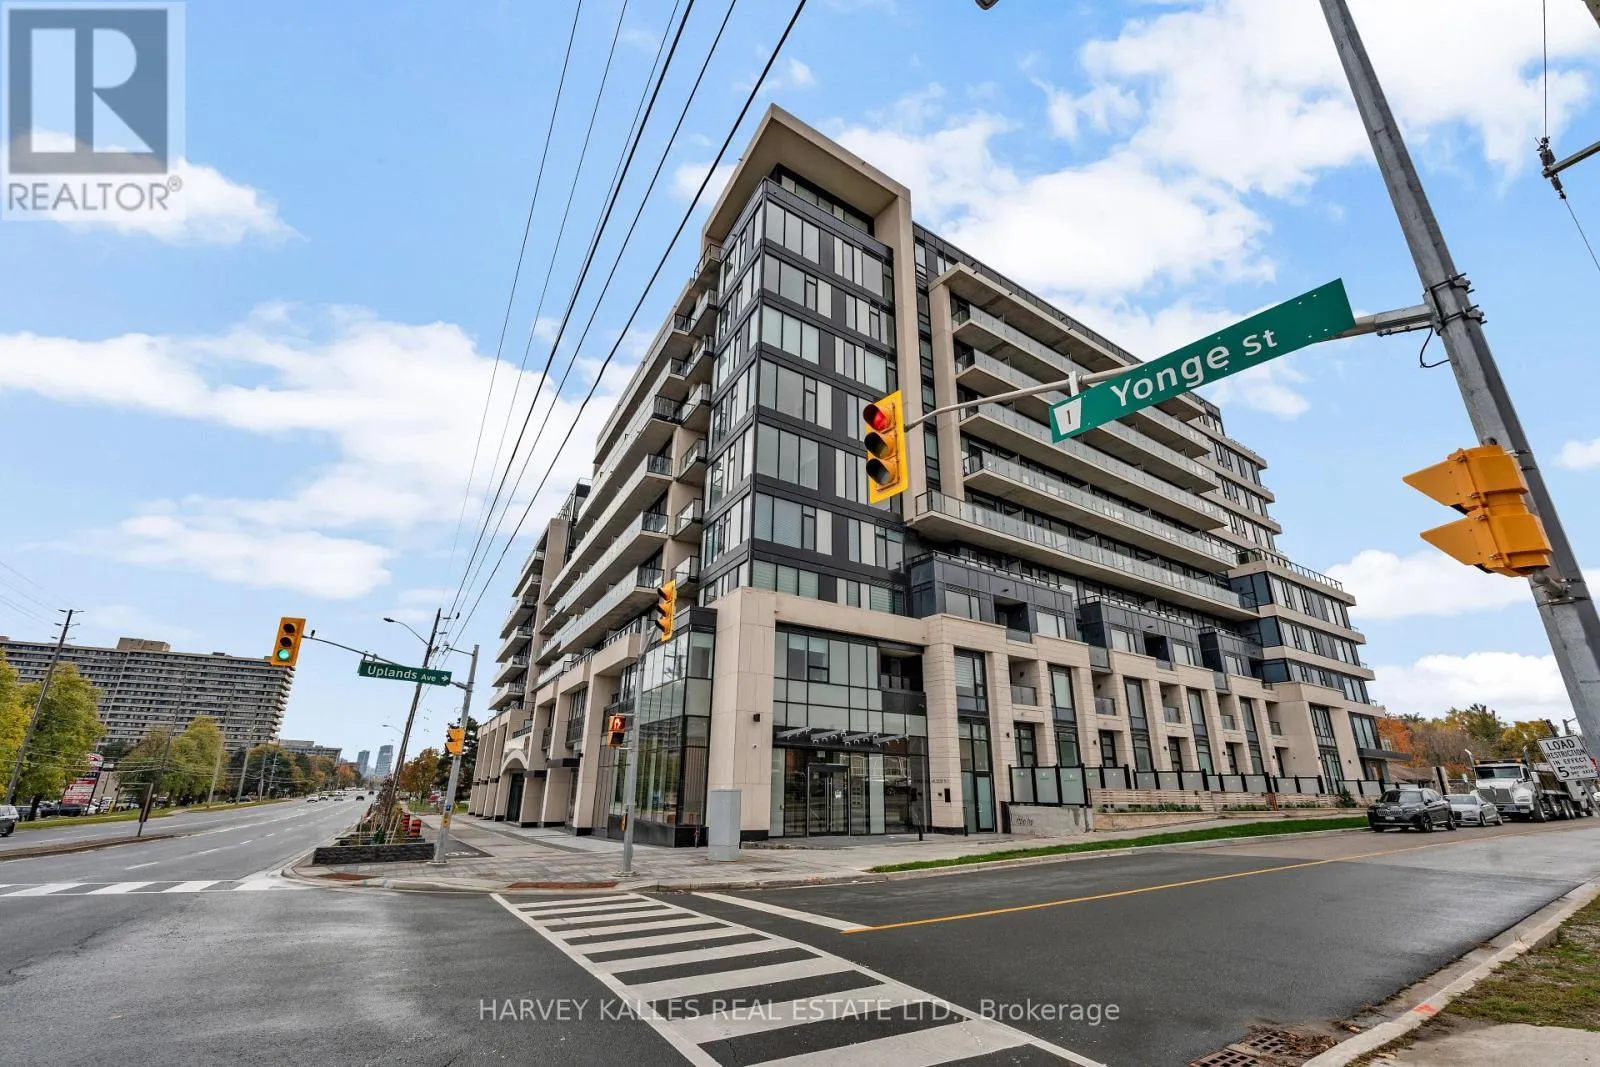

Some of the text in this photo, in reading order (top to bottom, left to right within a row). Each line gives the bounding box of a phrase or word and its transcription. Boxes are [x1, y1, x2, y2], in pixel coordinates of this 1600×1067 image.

[1110, 329, 1278, 407] Yonge St
[367, 665, 436, 682] Uplands Ave
[1546, 740, 1575, 750] LOAD
[1547, 748, 1587, 759] RESTRICTION
[1557, 766, 1570, 778] 5
